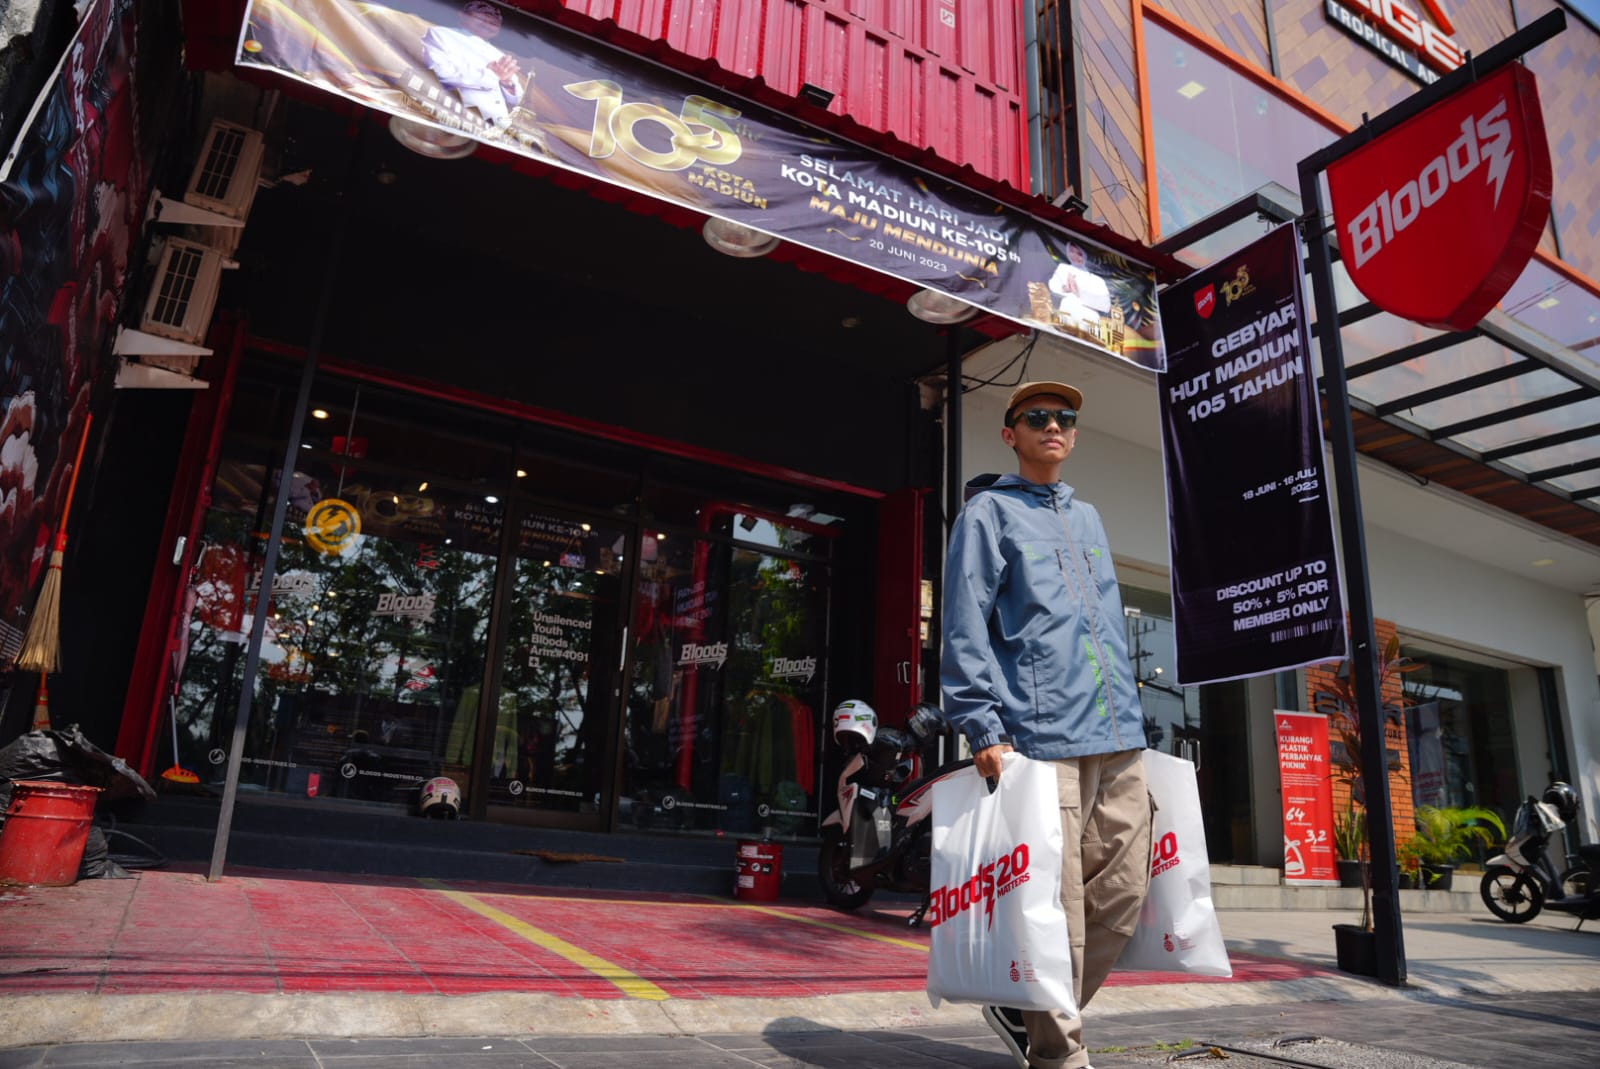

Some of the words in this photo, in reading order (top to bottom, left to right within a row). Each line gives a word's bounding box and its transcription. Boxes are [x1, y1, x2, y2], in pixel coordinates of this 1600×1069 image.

[1329, 1, 1409, 68] TROPICAL
[563, 79, 742, 171] 105
[687, 171, 768, 209] MADIUN
[703, 165, 756, 193] KOTA
[1347, 95, 1514, 271] Bloods
[780, 164, 841, 200] KOTA
[848, 190, 936, 234] MADIUN
[941, 226, 1021, 264] KE-105th
[800, 154, 903, 203] SELAMAT
[909, 195, 959, 225] HARI
[964, 219, 1010, 246] JADI
[809, 195, 878, 231] MAJU
[883, 223, 999, 277] MENDUNIA
[869, 238, 884, 251] 20
[887, 245, 916, 263] JUNI
[919, 256, 948, 272] 2023
[1211, 302, 1297, 358] GEBYAR
[1169, 371, 1211, 403] HUT
[1214, 328, 1300, 385] MADIUN
[1187, 393, 1226, 422] 105
[1229, 356, 1304, 404] TAHUN
[1255, 481, 1277, 496] JUNI
[1295, 466, 1317, 481] JULI
[1290, 479, 1319, 496] 2023
[1216, 573, 1284, 601] DISCOUNT
[1285, 566, 1302, 583] UP
[1304, 560, 1327, 576] TO
[1232, 596, 1263, 614] 50%
[1264, 597, 1272, 606] +
[1276, 587, 1296, 604] 5%
[1297, 579, 1329, 597] FOR
[533, 611, 592, 630] Unsilenced
[533, 622, 563, 636] Youth
[1233, 607, 1290, 632] MEMBER
[1292, 596, 1330, 617] ONLY
[531, 633, 568, 648] Bloods
[681, 640, 729, 660] Bloods
[773, 656, 817, 673] Bloods
[1279, 735, 1313, 745] KURANGI
[1280, 744, 1309, 753] PLASTIK
[1280, 752, 1323, 762] PERBANYAK
[1281, 760, 1306, 770] PIKNIK
[1286, 806, 1306, 821] 64
[1304, 829, 1327, 845] 3,2
[930, 862, 995, 932] Bloods
[996, 842, 1030, 888] 20
[997, 872, 1030, 899] MATTERS
